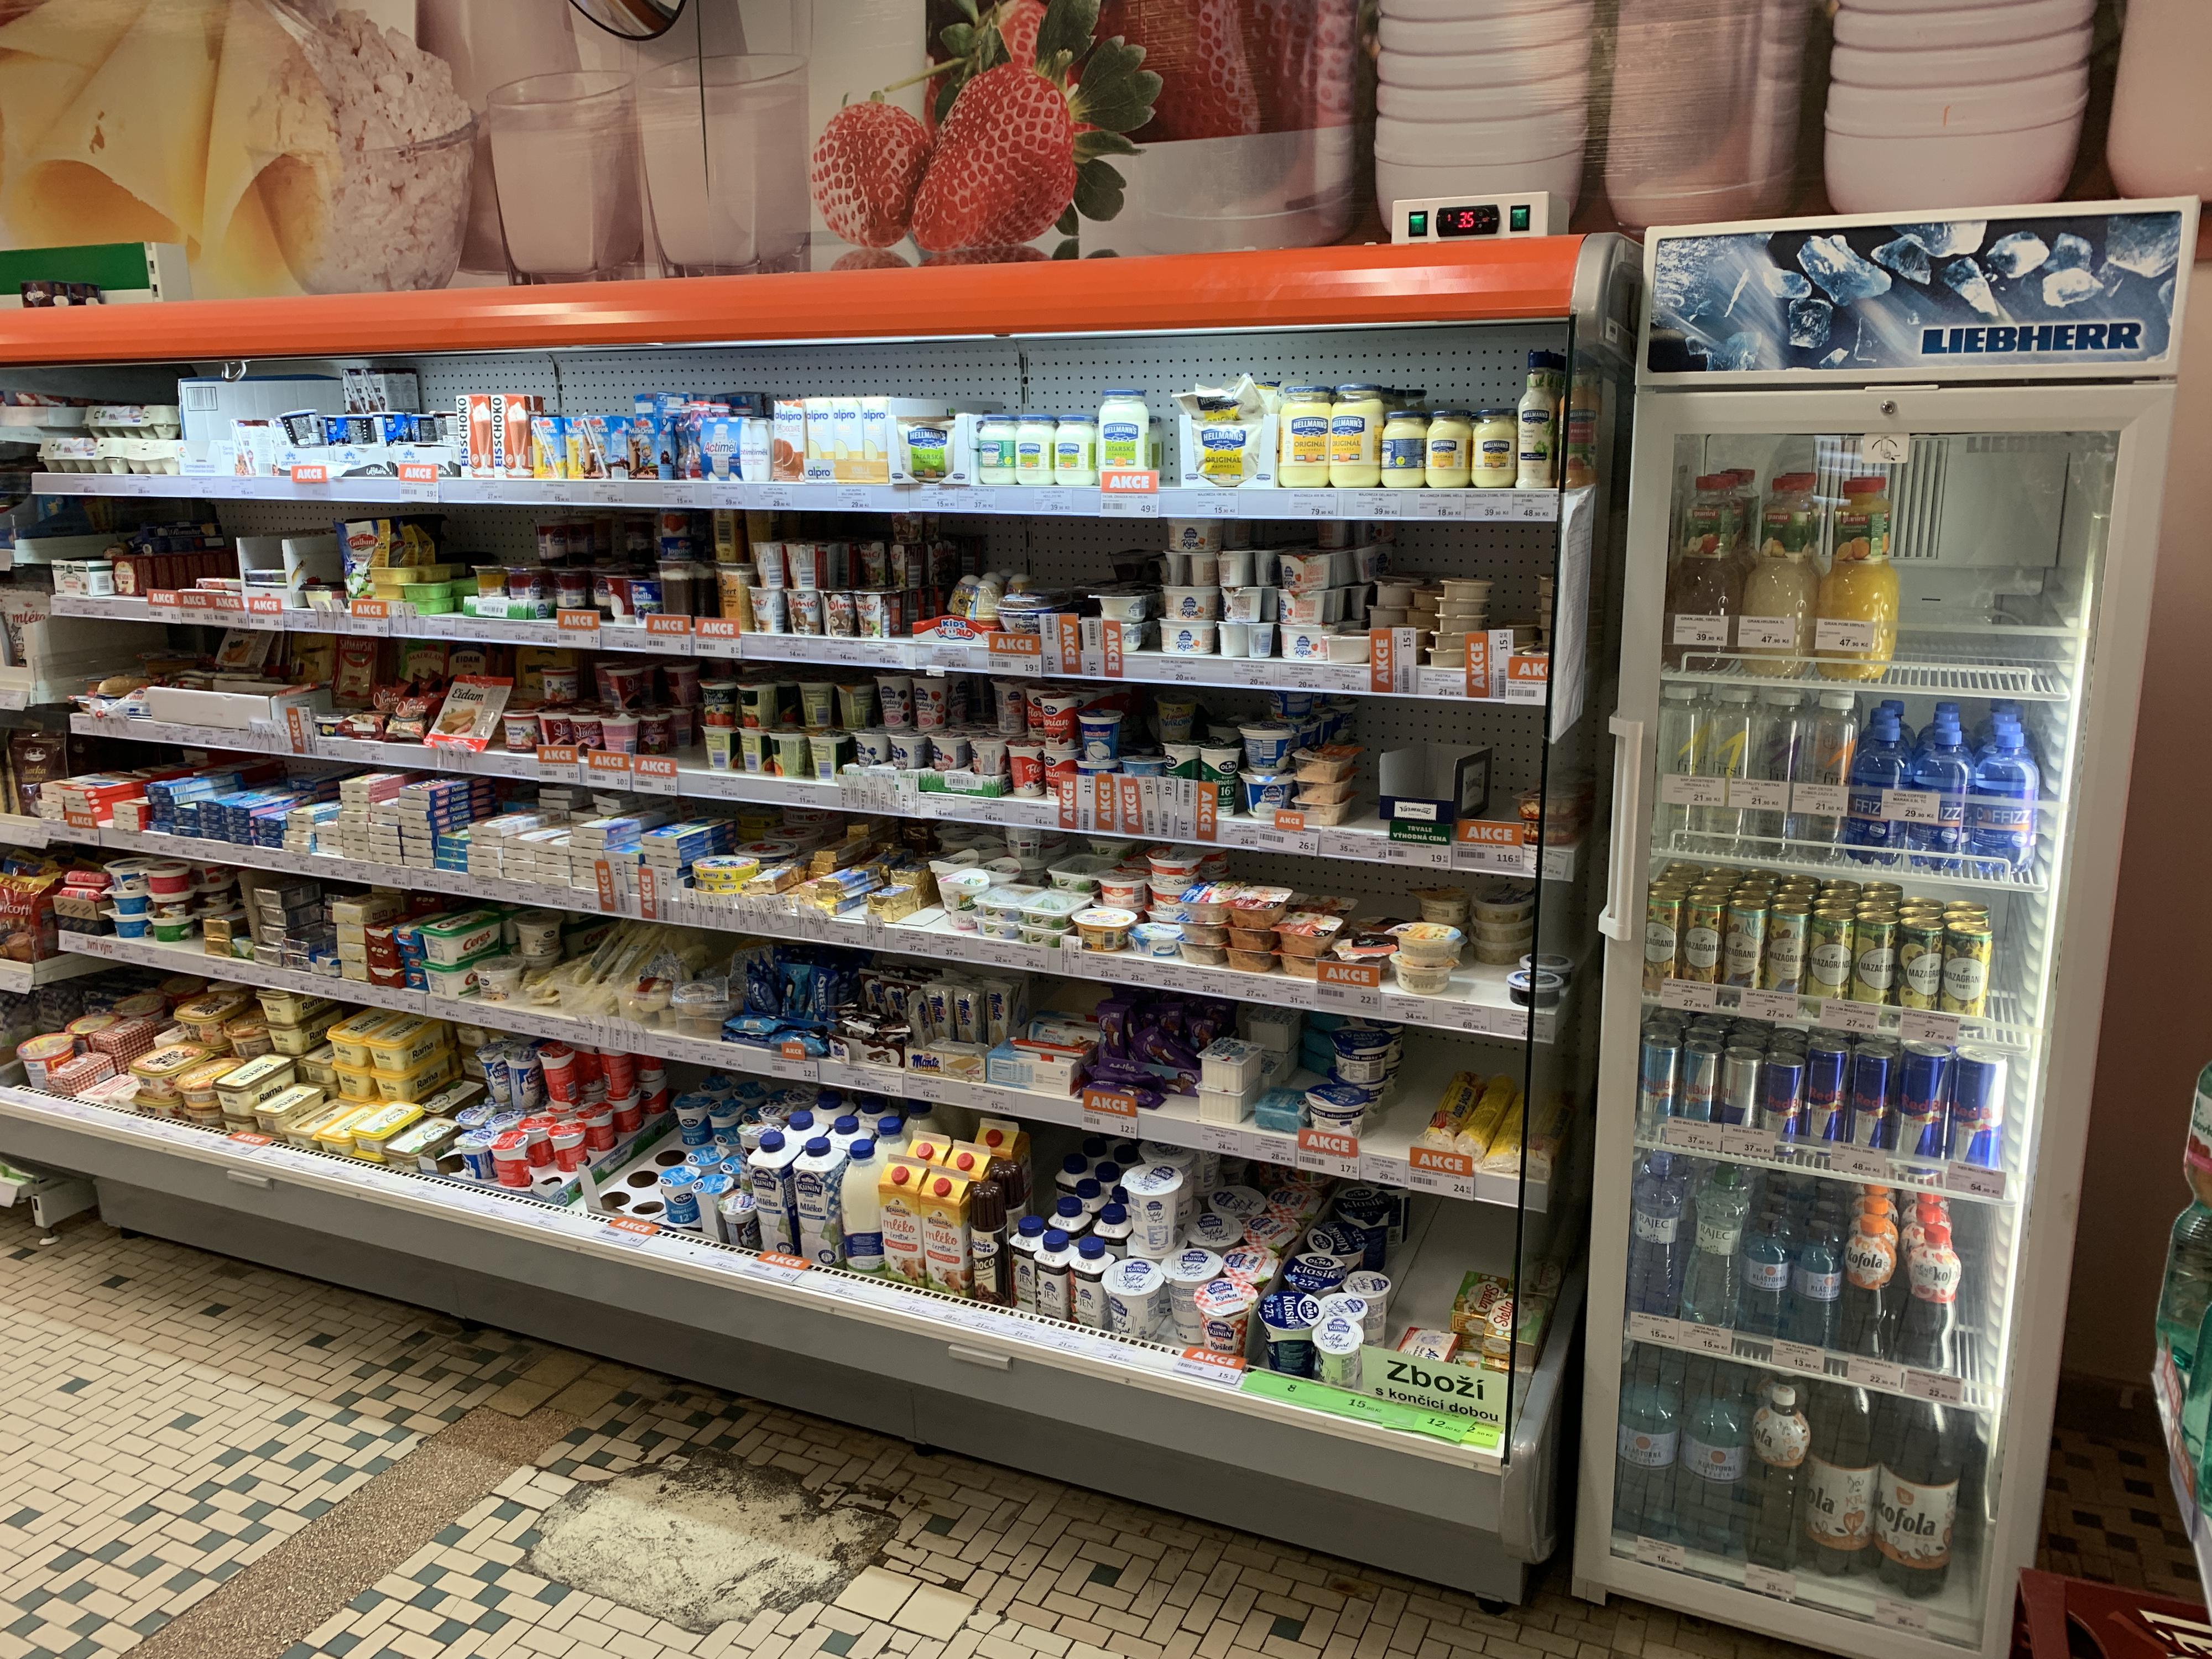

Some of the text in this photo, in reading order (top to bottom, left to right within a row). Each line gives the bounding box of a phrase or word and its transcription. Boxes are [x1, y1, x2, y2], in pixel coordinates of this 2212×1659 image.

[1921, 322, 2142, 354] LIEBHERR
[781, 411, 802, 422] alpro
[807, 412, 828, 422] alpro
[833, 411, 855, 422] alpro
[863, 411, 885, 422] alpro
[1104, 425, 1138, 435] HELLMANN'S
[1293, 419, 1328, 429] HELLMANN'S
[458, 398, 468, 467] EISSCHOKO
[493, 398, 503, 467] EISSCHOKO
[1203, 430, 1244, 441] HELLMANN'S
[703, 442, 737, 453] Actimel
[297, 468, 322, 479] AKCE
[404, 467, 431, 479] AKCE
[808, 467, 830, 479] alpro
[1110, 476, 1150, 489] AKCE
[349, 538, 376, 547] Galbani
[152, 593, 175, 604] AKCE
[182, 596, 206, 606] AKCE
[216, 598, 239, 608] AKCE
[254, 601, 277, 611] AKCE
[356, 606, 382, 615] AKCE
[564, 616, 593, 627] AKCE
[653, 620, 684, 632] AKCE
[702, 623, 734, 635] AKCE
[997, 638, 1032, 650] AKCE
[1062, 624, 1074, 664] AKCE
[1107, 628, 1118, 670] AKCE
[1376, 639, 1389, 684] AKCE
[1470, 642, 1484, 688] AKCE
[452, 688, 484, 701] Eidam
[294, 713, 303, 747] AKCE
[543, 750, 572, 760] AKCE
[594, 755, 623, 768] AKCE
[640, 760, 671, 773] AKCE
[1062, 780, 1073, 822] AKCE
[1100, 781, 1111, 823] AKCE
[1124, 785, 1139, 826] AKCE
[1200, 790, 1211, 832] AKCE
[72, 817, 93, 826] AKCE
[1393, 832, 1428, 840] VÝHODNÁ
[1467, 826, 1513, 841] AKCE
[602, 868, 612, 904] AKCE
[641, 875, 653, 912] AKCE
[462, 931, 491, 951] Ceres
[1327, 967, 1369, 983] AKCE
[816, 973, 827, 1013] OREO
[350, 1016, 382, 1033] Rama
[337, 1047, 352, 1056] Rama
[412, 1042, 434, 1058] Rama
[342, 1076, 357, 1084] Rama
[416, 1072, 439, 1089] Rama
[259, 1085, 283, 1102] Rama
[382, 1083, 397, 1092] Rama
[1091, 1095, 1129, 1112] AKCE
[682, 1119, 697, 1128] OLMA
[234, 1133, 267, 1144] AKCE
[1307, 1135, 1349, 1152] AKCE
[1418, 1153, 1463, 1172] AKCE
[674, 1193, 692, 1204] OLMA
[618, 1220, 651, 1233] AKCE
[884, 1219, 915, 1234] mléko
[1639, 1213, 1670, 1229] RAJEC
[925, 1230, 957, 1245] mléko
[1700, 1224, 1730, 1240] RAJEC
[768, 1254, 802, 1268] AKCE
[1307, 1258, 1332, 1267] OLMA
[1848, 1247, 1882, 1269] kofola
[1292, 1265, 1335, 1279] Klasik
[1019, 1274, 1032, 1285] JEN
[1044, 1290, 1058, 1301] JEN
[1478, 1284, 1499, 1310] Stella
[1079, 1297, 1094, 1309] JEN
[1283, 1296, 1296, 1326] Klasik
[1304, 1301, 1315, 1320] OLMA
[1210, 1341, 1233, 1352] Kyška
[1192, 1351, 1238, 1366] AKCE
[1386, 1360, 1485, 1401] Zboží
[1375, 1387, 1499, 1422] s končící dobou
